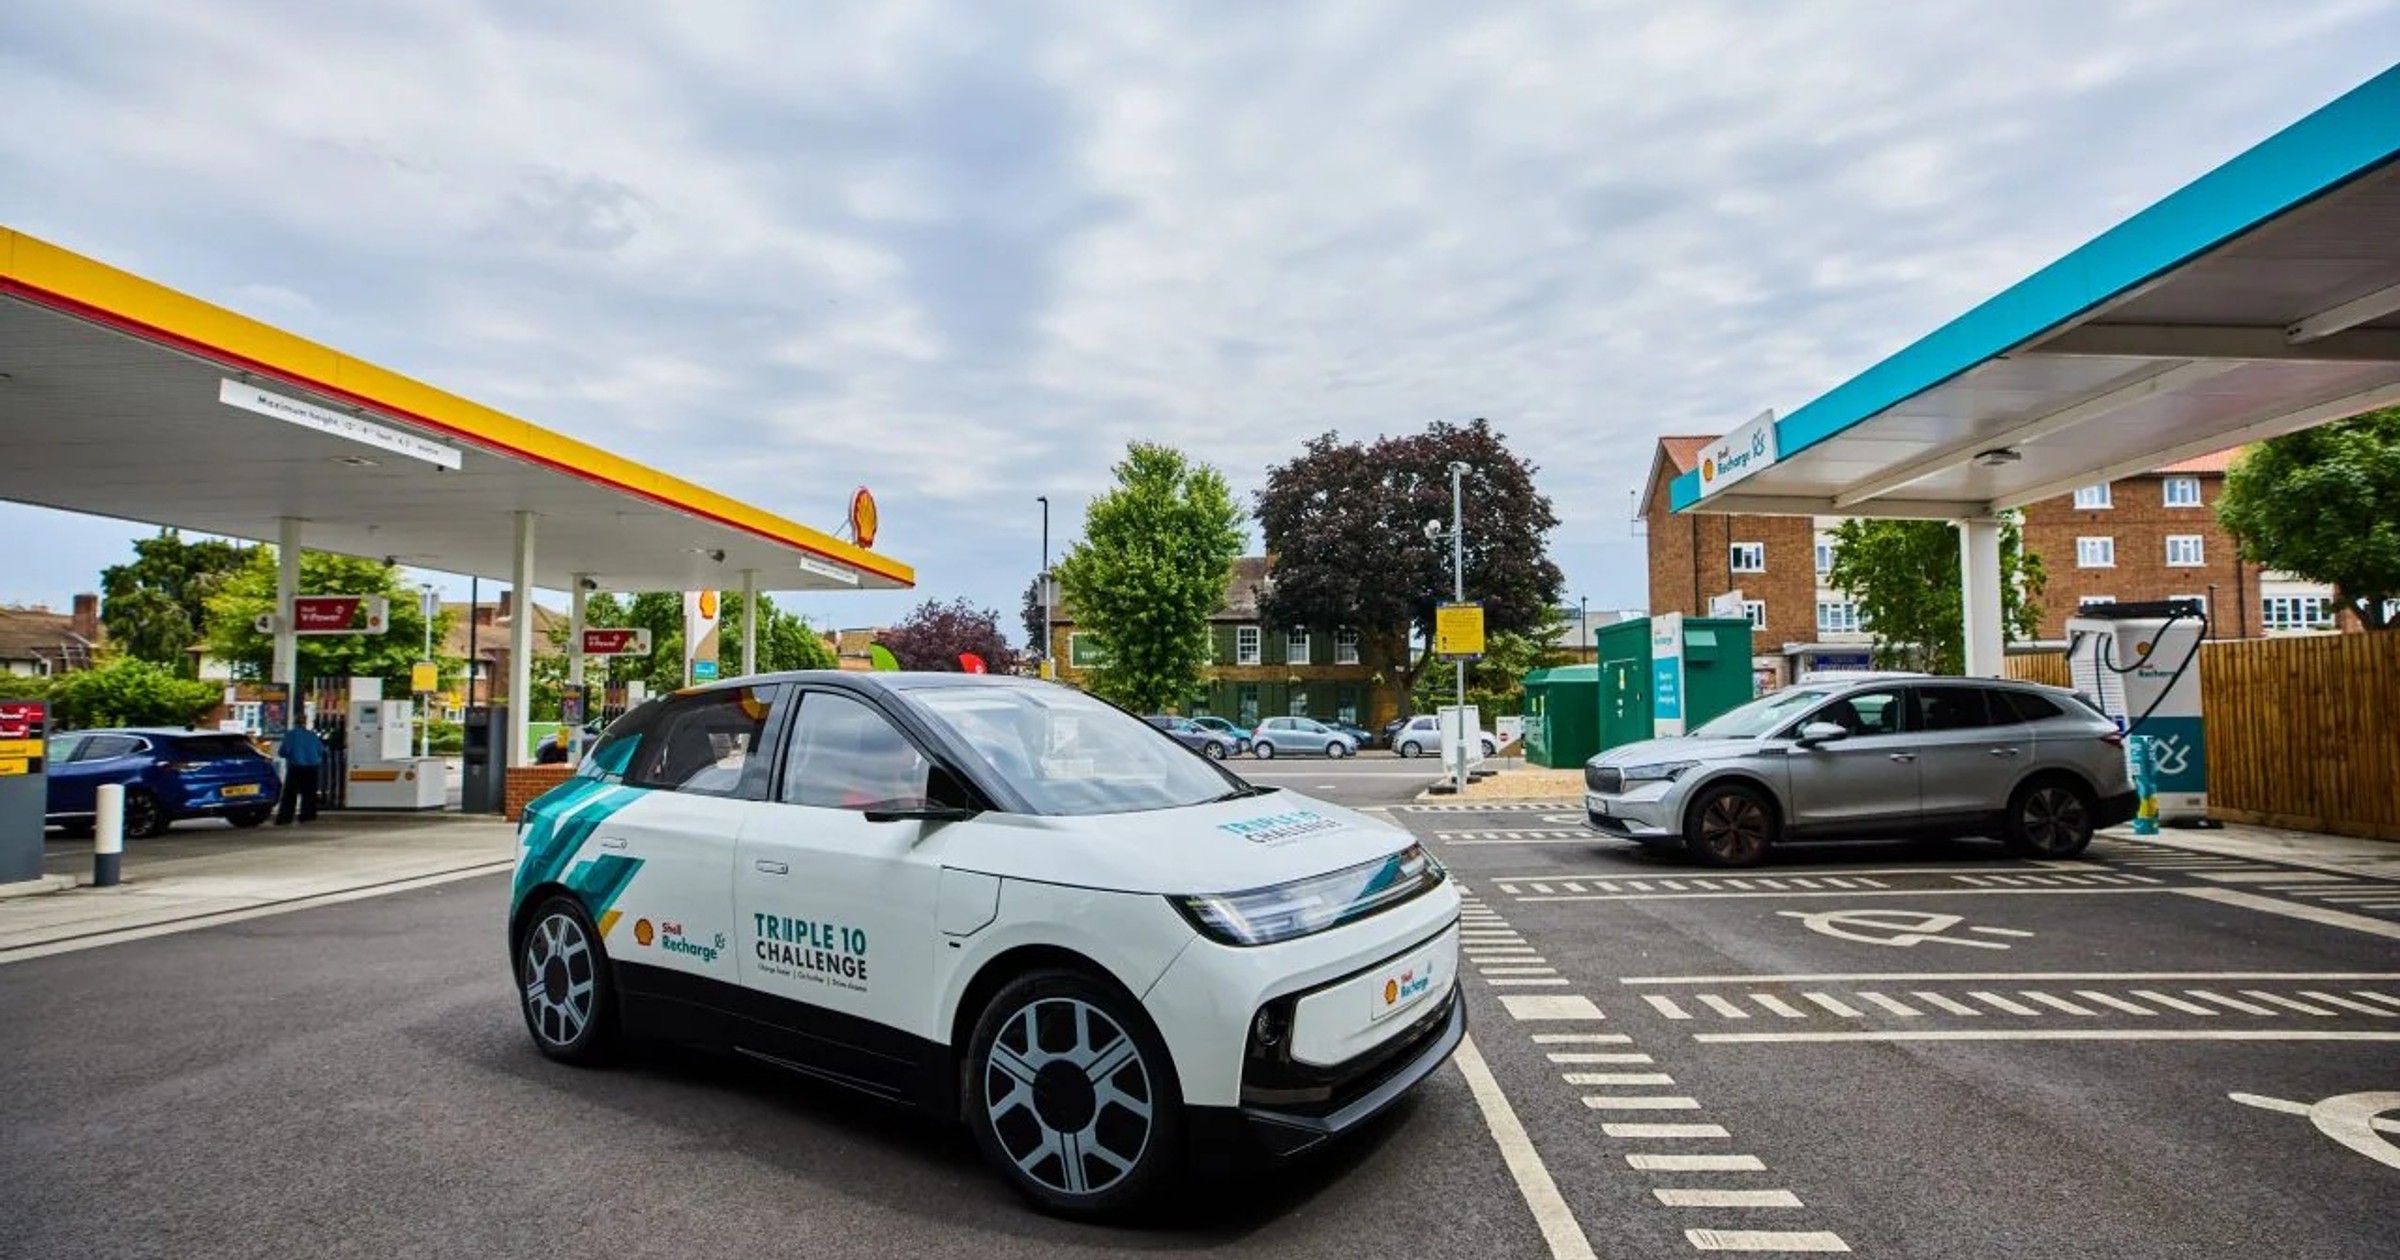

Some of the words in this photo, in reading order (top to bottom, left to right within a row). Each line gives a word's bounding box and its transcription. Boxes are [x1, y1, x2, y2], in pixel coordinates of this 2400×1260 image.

[662, 922, 682, 936] Shell
[841, 927, 867, 956] 10
[662, 934, 718, 962] Recharge
[756, 941, 868, 980] CHALLENGE
